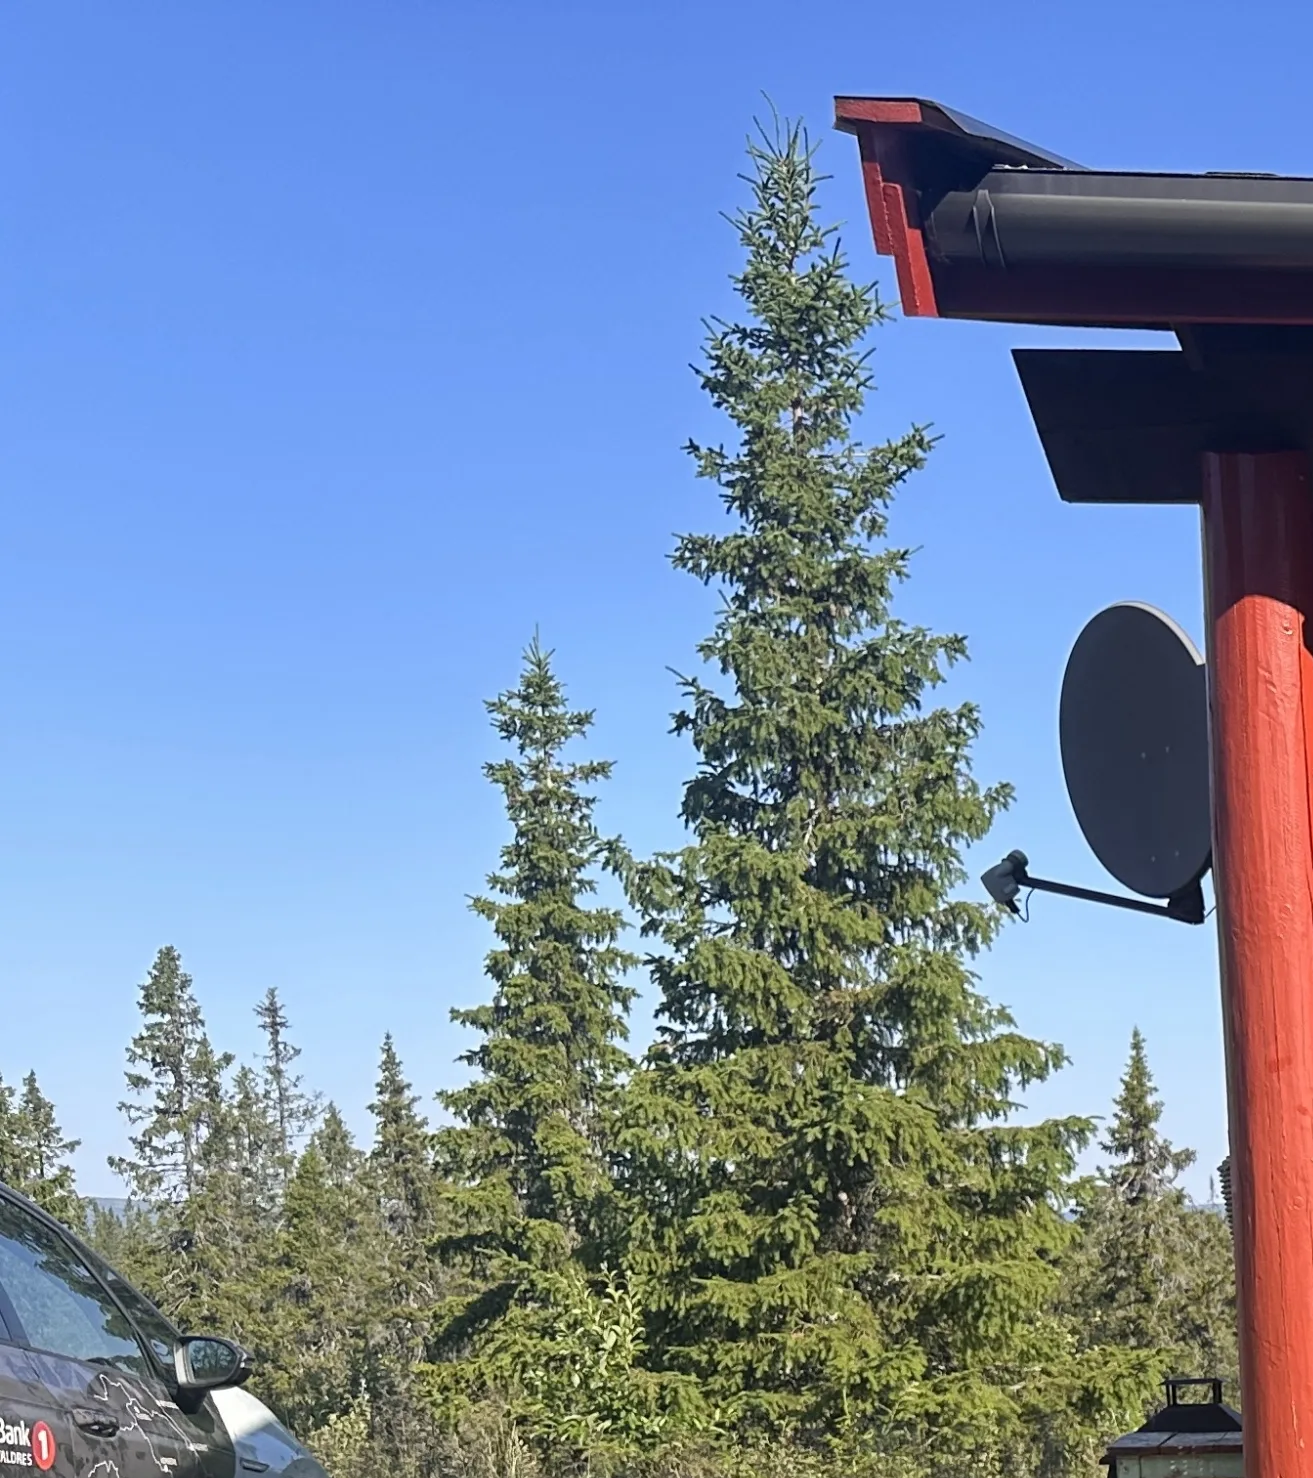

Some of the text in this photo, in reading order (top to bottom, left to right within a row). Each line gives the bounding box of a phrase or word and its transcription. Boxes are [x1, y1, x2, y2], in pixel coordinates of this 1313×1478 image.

[0, 1417, 49, 1460] Bank 1
[0, 1450, 32, 1466] ALDRES
